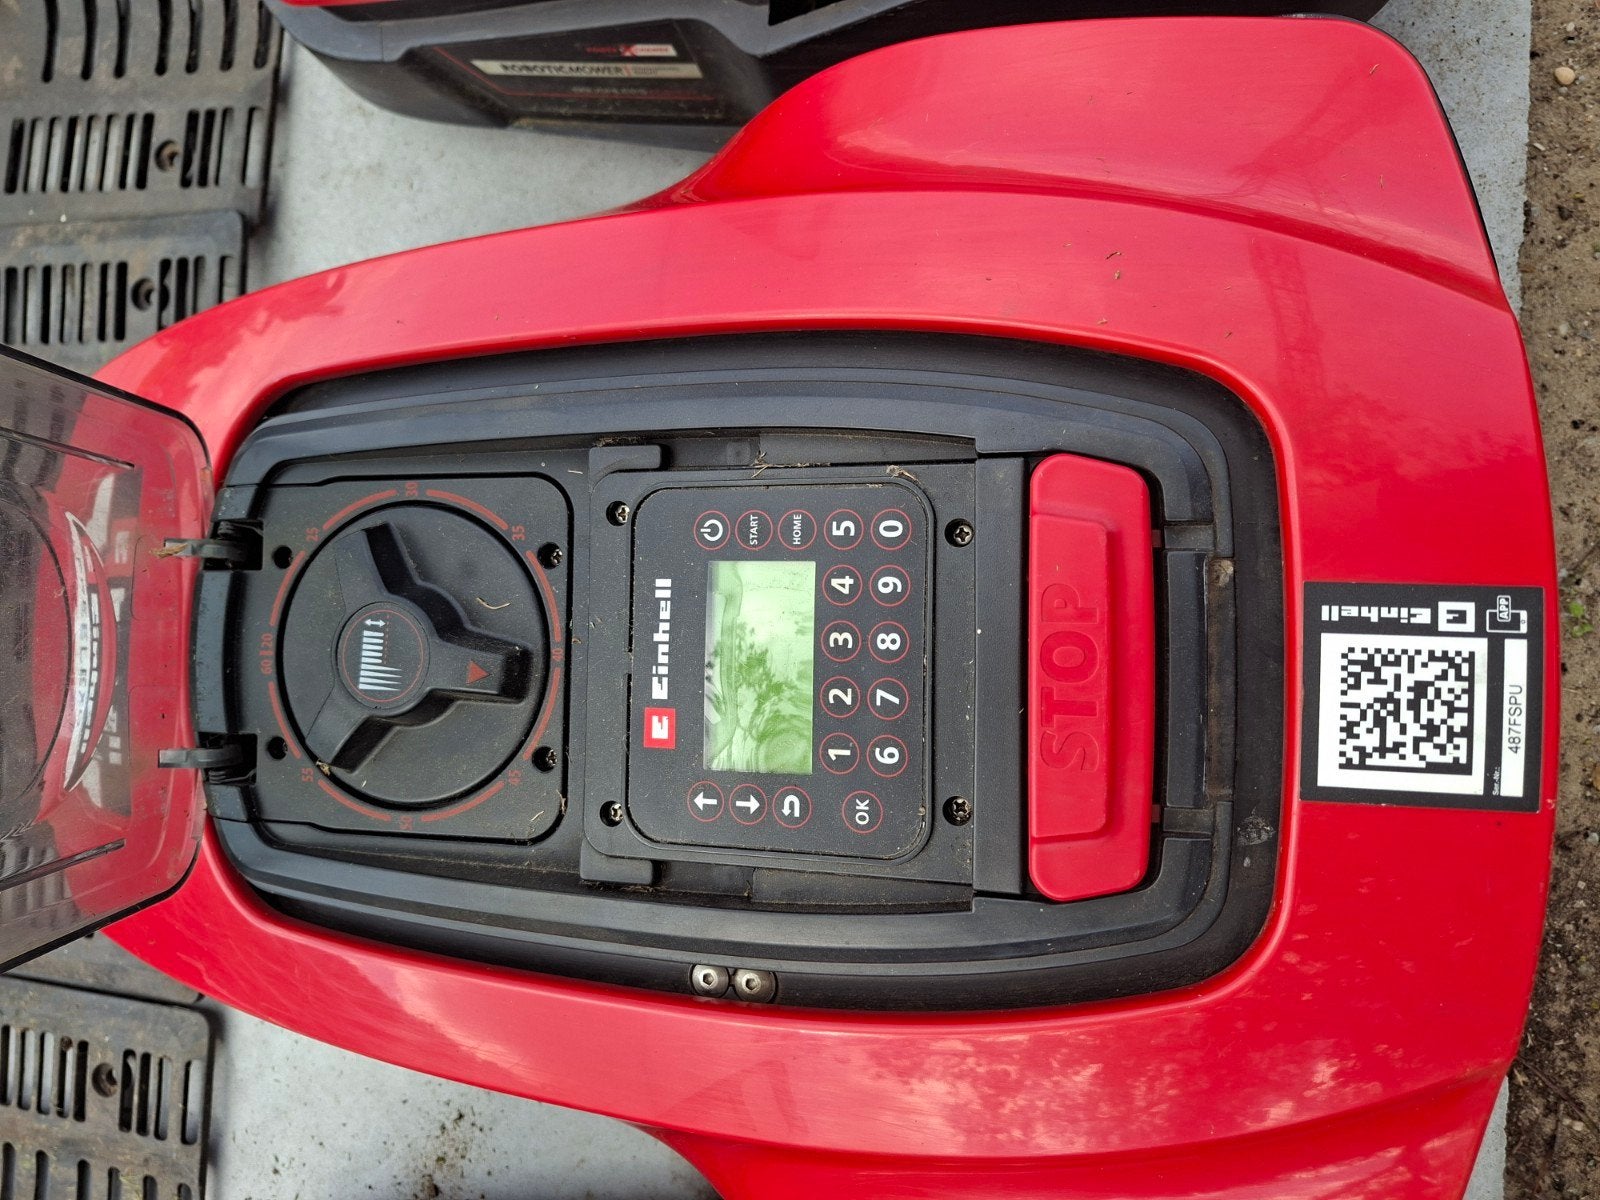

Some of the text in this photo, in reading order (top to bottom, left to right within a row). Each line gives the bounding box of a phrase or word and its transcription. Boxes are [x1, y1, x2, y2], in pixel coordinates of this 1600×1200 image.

[406, 482, 418, 497] 30
[306, 527, 319, 542] 25
[513, 525, 525, 541] 35
[750, 515, 758, 545] START
[793, 514, 801, 545] HOME
[832, 520, 855, 536] 5
[879, 520, 903, 537] 0
[831, 575, 854, 594] 4
[878, 576, 902, 593] 9
[1321, 605, 1431, 624] Einhell
[1499, 598, 1510, 620] APP
[262, 633, 273, 648] 20
[651, 578, 672, 700] Einhell
[830, 632, 853, 649] 3
[877, 632, 901, 651] 8
[554, 647, 564, 662] 40
[261, 659, 272, 674] 60
[1040, 583, 1099, 772] STOP
[829, 688, 852, 705] 2
[876, 689, 900, 706] 7
[1508, 684, 1523, 754] 487FSPU
[828, 748, 851, 761] 1
[876, 746, 899, 764] 6
[302, 767, 313, 782] 55
[509, 769, 521, 784] 45
[855, 799, 870, 825] OK
[401, 816, 413, 831] 50
